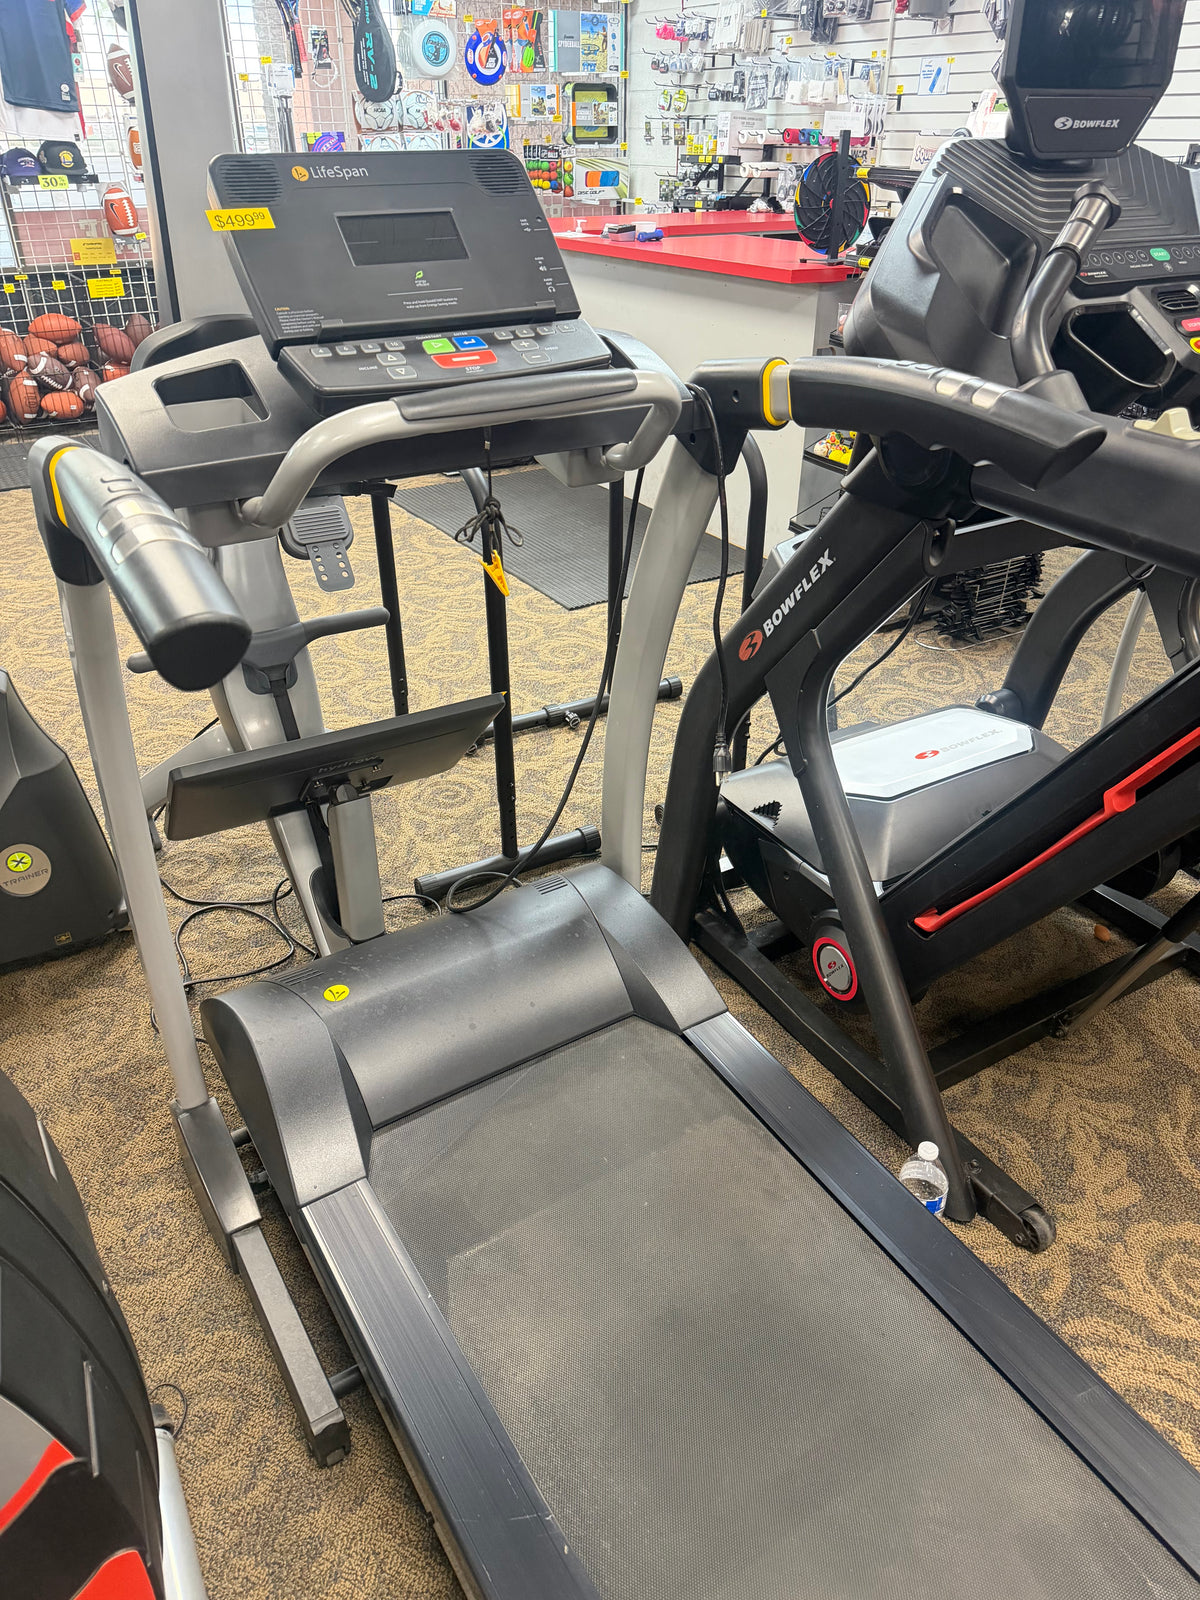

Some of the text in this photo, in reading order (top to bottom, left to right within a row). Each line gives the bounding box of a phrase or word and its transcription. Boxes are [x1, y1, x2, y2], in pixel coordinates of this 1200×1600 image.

[365, 32, 378, 90] RV-2
[1072, 119, 1120, 129] BOWFLEX
[42, 177, 58, 188] 30
[309, 166, 369, 180] LifeSpan
[763, 548, 834, 638] BOWFLEX
[940, 728, 1000, 753] BOWFLEX
[3, 868, 49, 887] TRAINER
